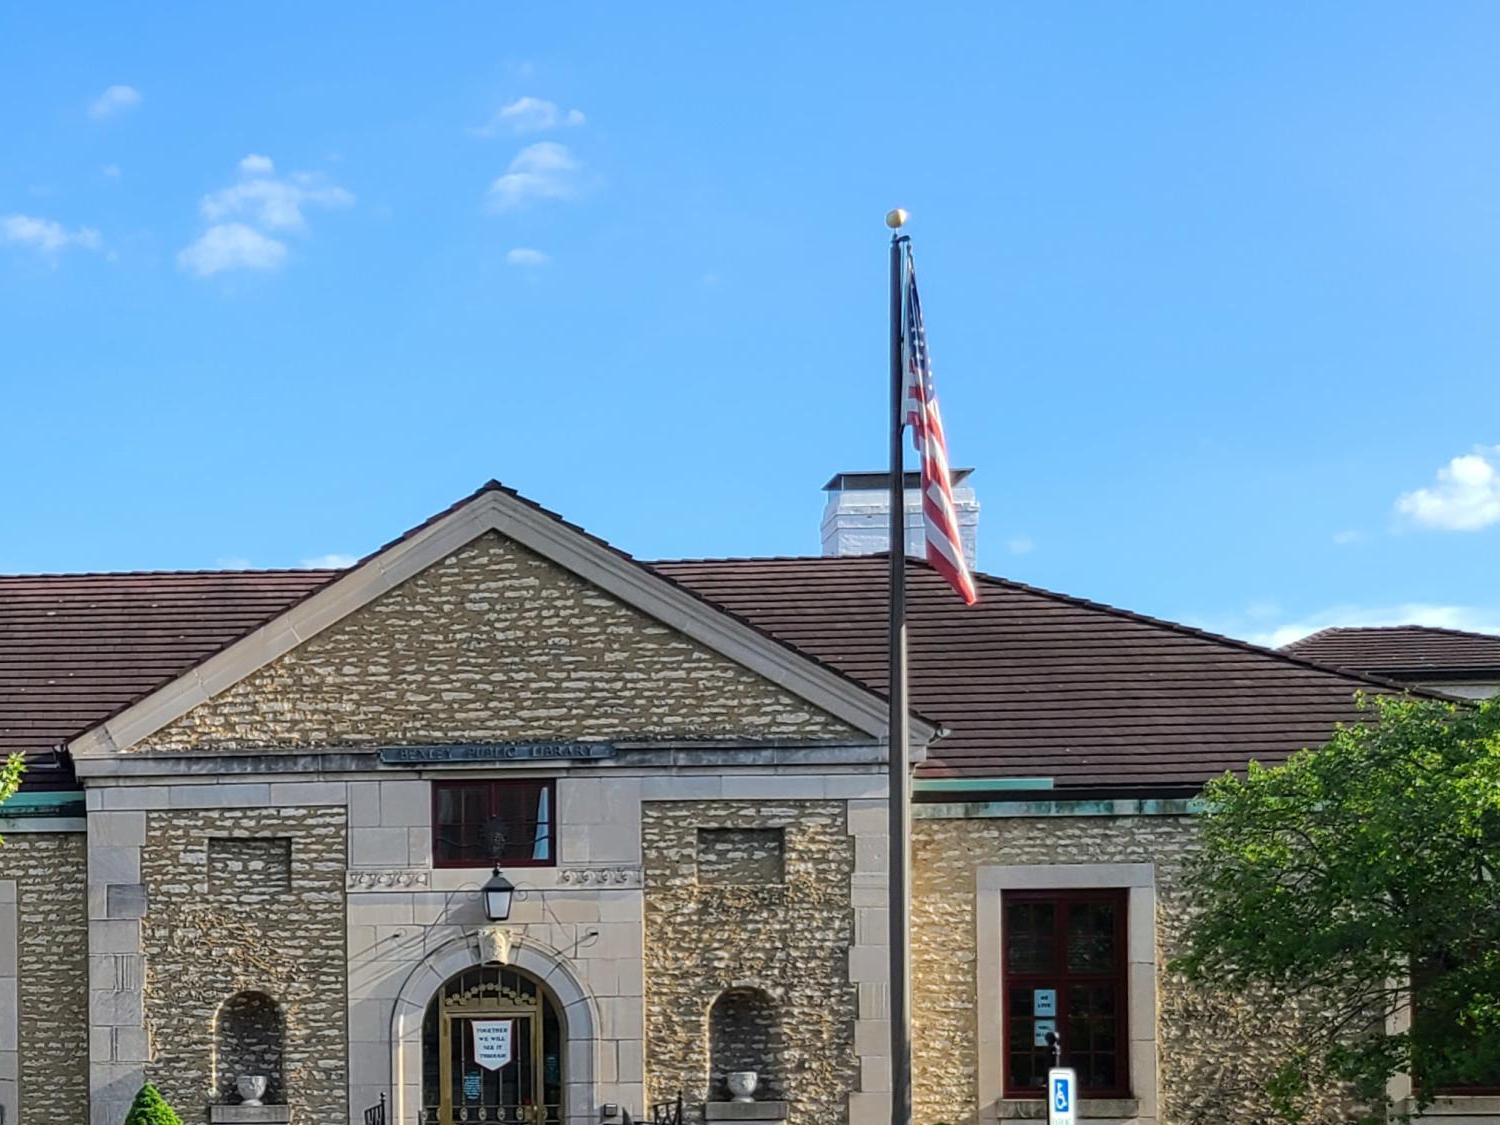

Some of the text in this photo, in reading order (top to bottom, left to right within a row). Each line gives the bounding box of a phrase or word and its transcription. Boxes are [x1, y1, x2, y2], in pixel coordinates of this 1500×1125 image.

[400, 744, 594, 760] BEXLEY PUBLIC LIBRARY
